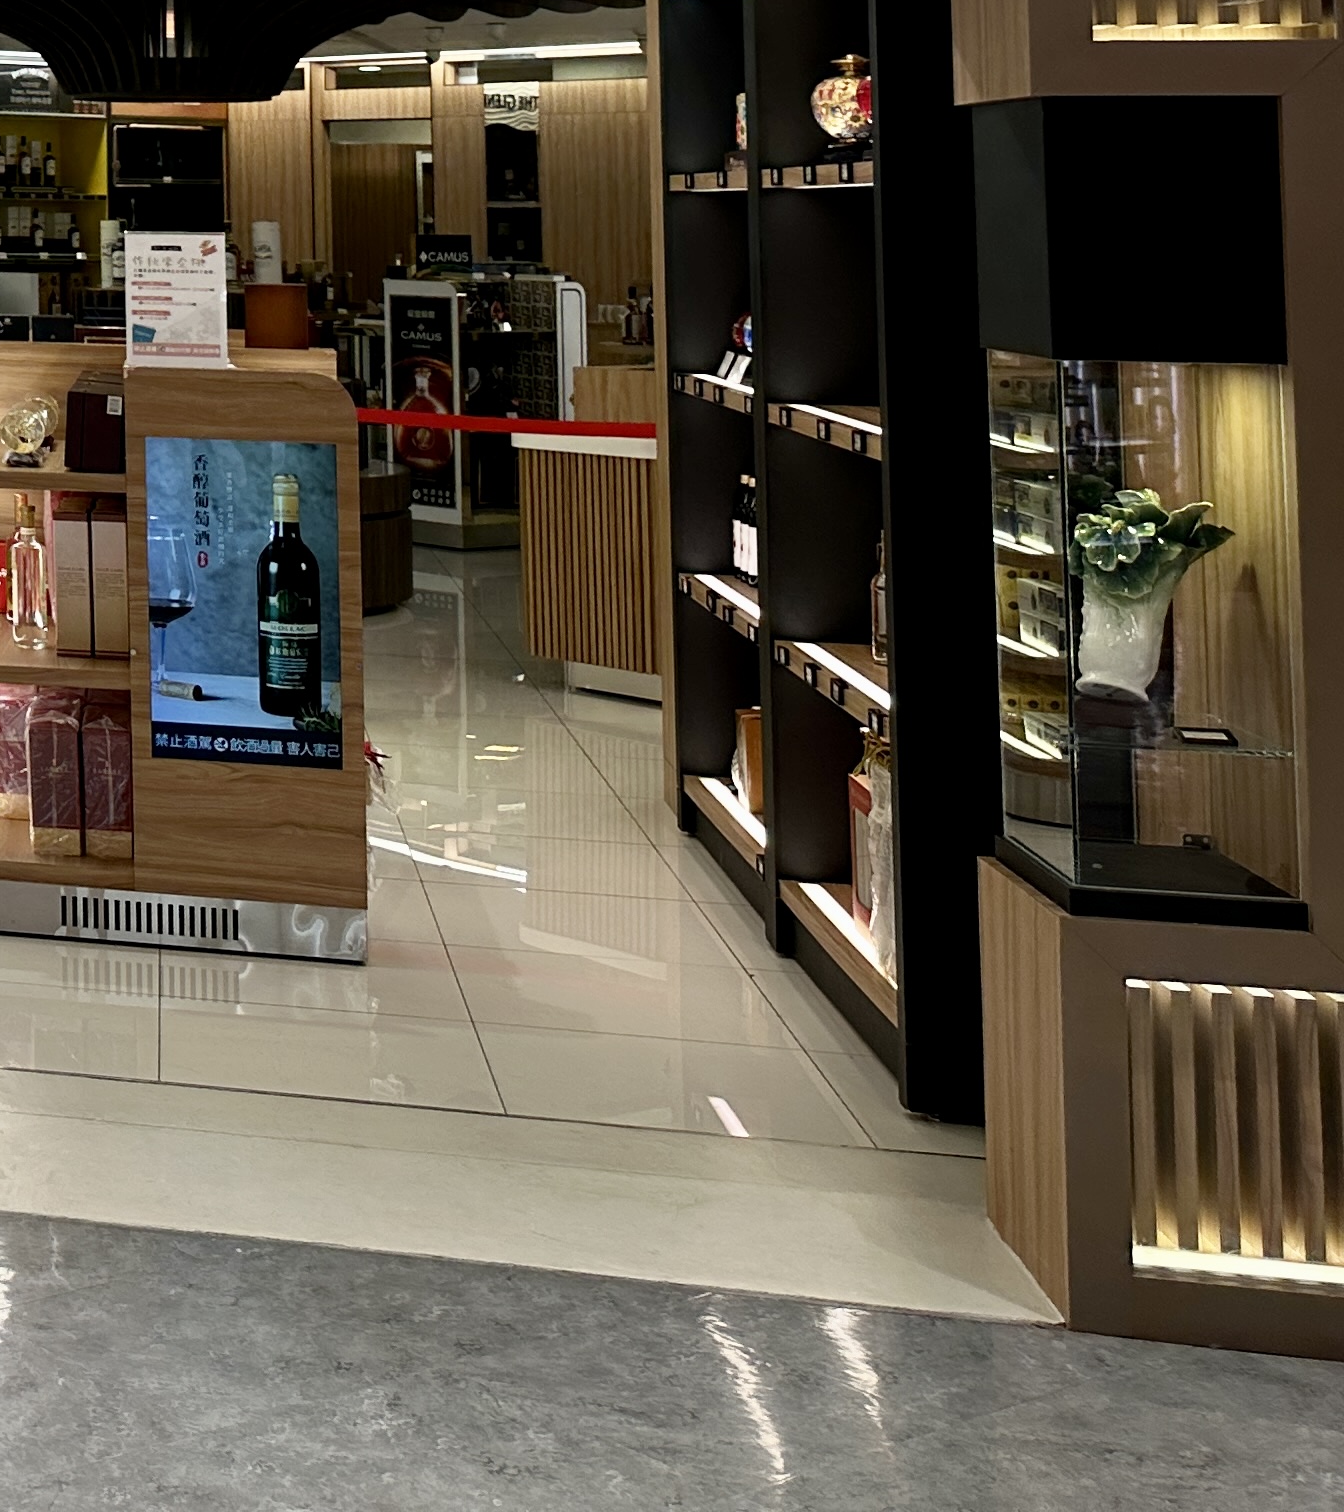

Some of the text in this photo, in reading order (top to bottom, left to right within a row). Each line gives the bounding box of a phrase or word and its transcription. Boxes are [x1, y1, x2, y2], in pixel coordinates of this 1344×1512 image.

[428, 252, 469, 263] CAMUS
[401, 331, 442, 342] CAMUS
[192, 454, 210, 546] 香醇葡萄酒
[155, 733, 340, 758] 禁止酒駕 飲酒過量 害人害己
